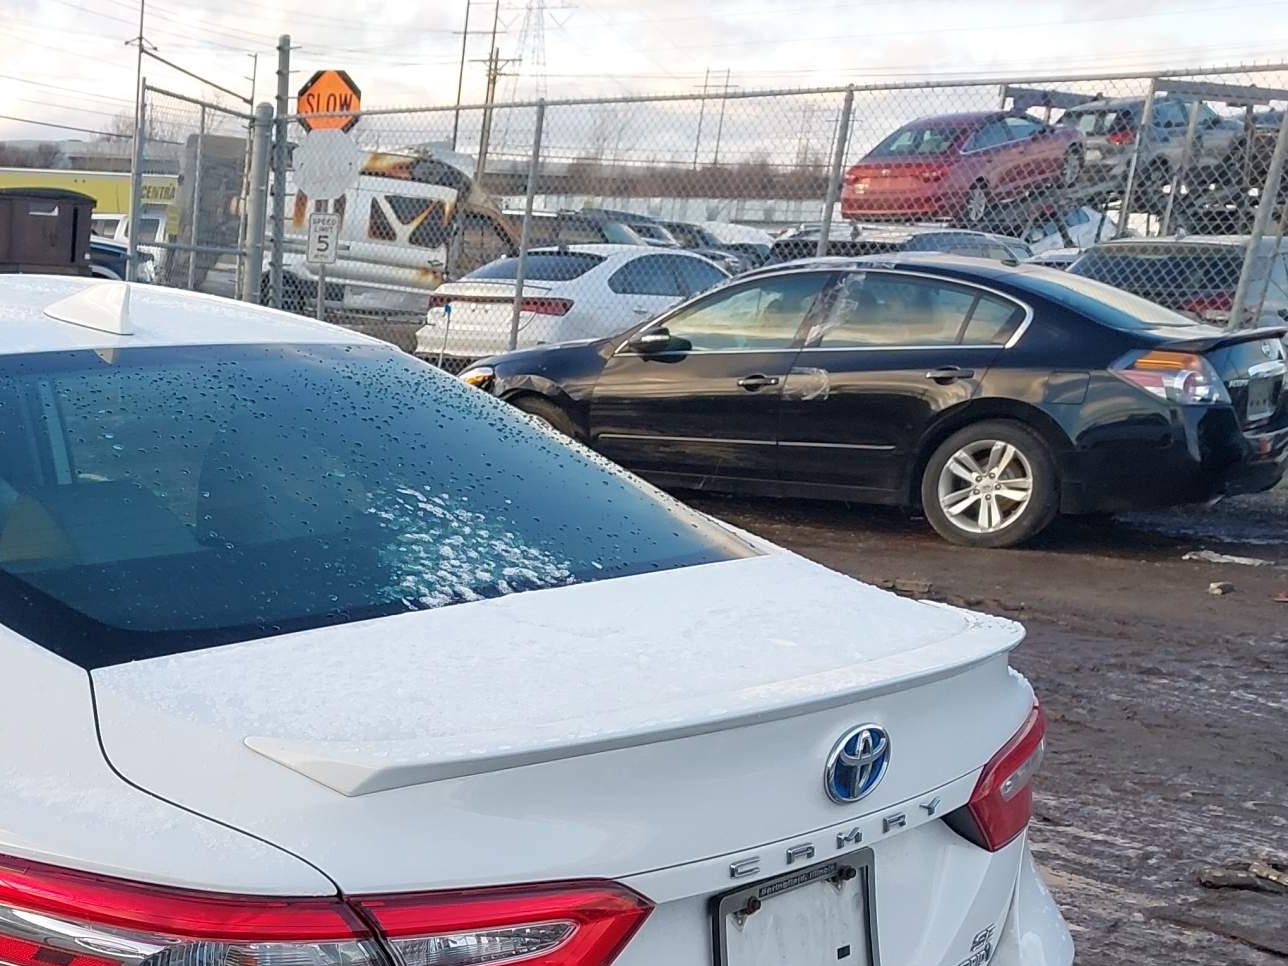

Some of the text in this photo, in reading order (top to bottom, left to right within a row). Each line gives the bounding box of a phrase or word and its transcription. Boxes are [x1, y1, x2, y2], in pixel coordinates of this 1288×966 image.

[305, 92, 353, 113] SLOW
[312, 218, 337, 226] SPEED
[314, 225, 334, 233] LIMIT
[316, 235, 330, 252] 5
[729, 796, 942, 880] CAMRY
